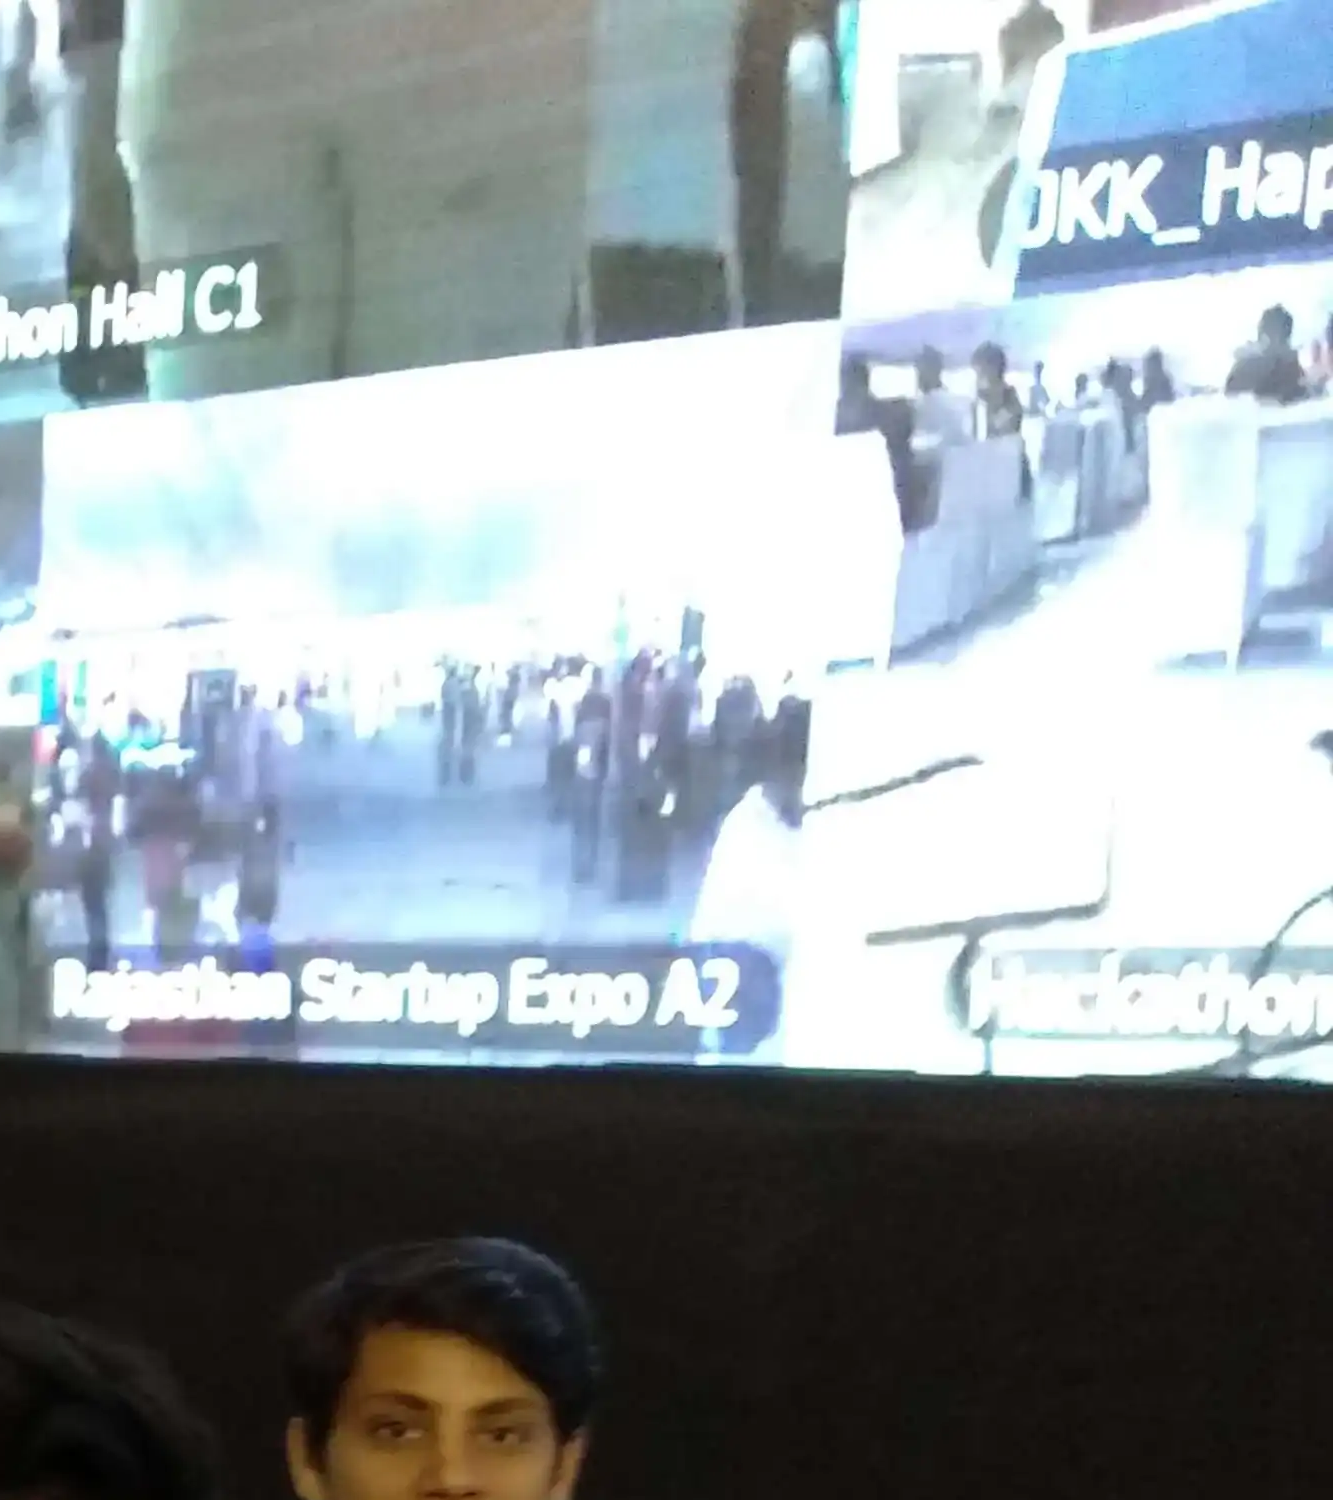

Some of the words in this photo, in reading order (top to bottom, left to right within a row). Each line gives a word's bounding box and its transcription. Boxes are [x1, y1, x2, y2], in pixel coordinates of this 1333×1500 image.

[89, 268, 186, 349] Hall
[194, 258, 263, 334] C1
[53, 955, 292, 1033] Rajasthan
[299, 957, 500, 1036] Startup
[507, 957, 651, 1038] Expo
[654, 957, 741, 1028] A2
